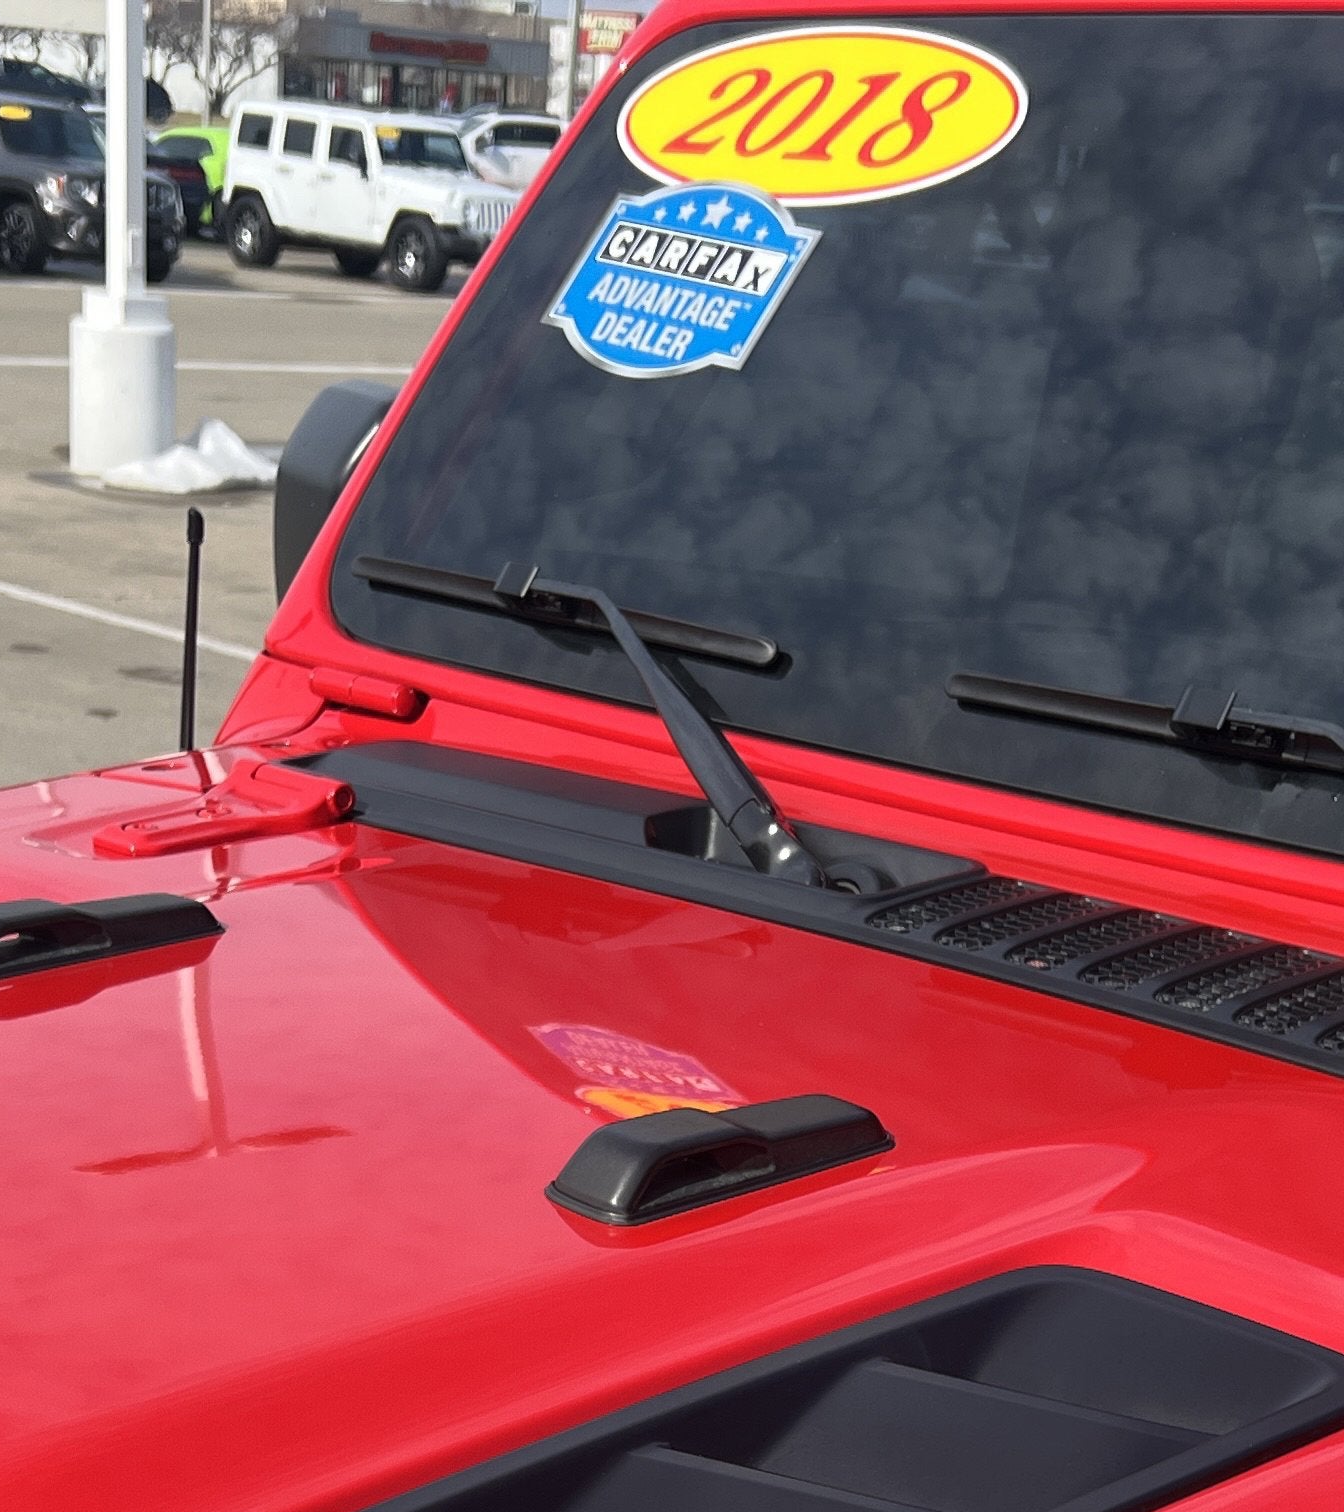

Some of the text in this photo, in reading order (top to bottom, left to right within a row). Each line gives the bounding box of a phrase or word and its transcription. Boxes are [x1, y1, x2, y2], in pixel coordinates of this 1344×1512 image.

[660, 68, 971, 168] 2018
[607, 228, 770, 293] CARFAX
[587, 271, 742, 331] ADVANTAGE
[590, 310, 695, 361] DEALER
